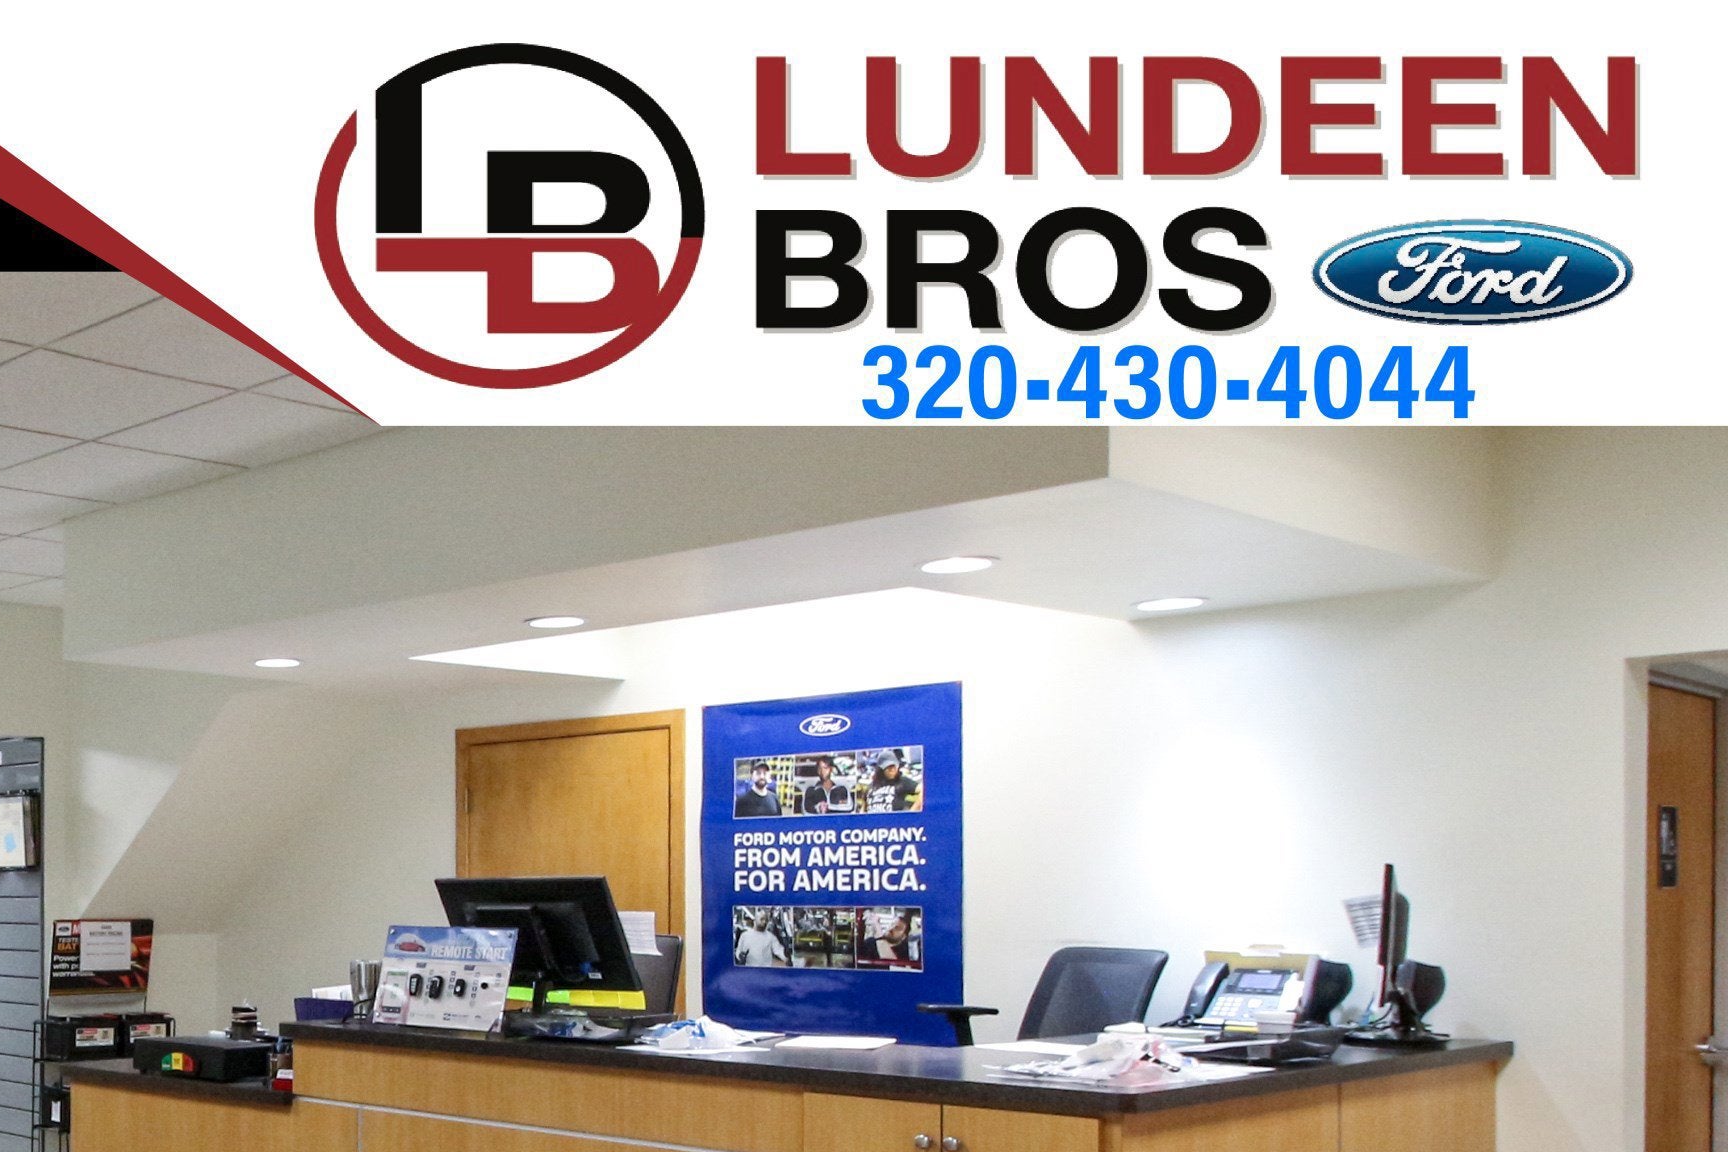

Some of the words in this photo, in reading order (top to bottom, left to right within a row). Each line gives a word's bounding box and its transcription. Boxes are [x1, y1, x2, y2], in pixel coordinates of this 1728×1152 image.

[808, 717, 842, 733] Ford
[733, 832, 775, 846] FORD
[779, 829, 837, 845] MOTOR
[840, 827, 927, 844] COMPANY.
[734, 848, 801, 868] FROM
[807, 844, 927, 867] AMERICA.
[734, 869, 786, 892] FOR
[792, 868, 927, 892] AMERICA.
[431, 944, 472, 959] REMOTE
[475, 946, 509, 960] START
